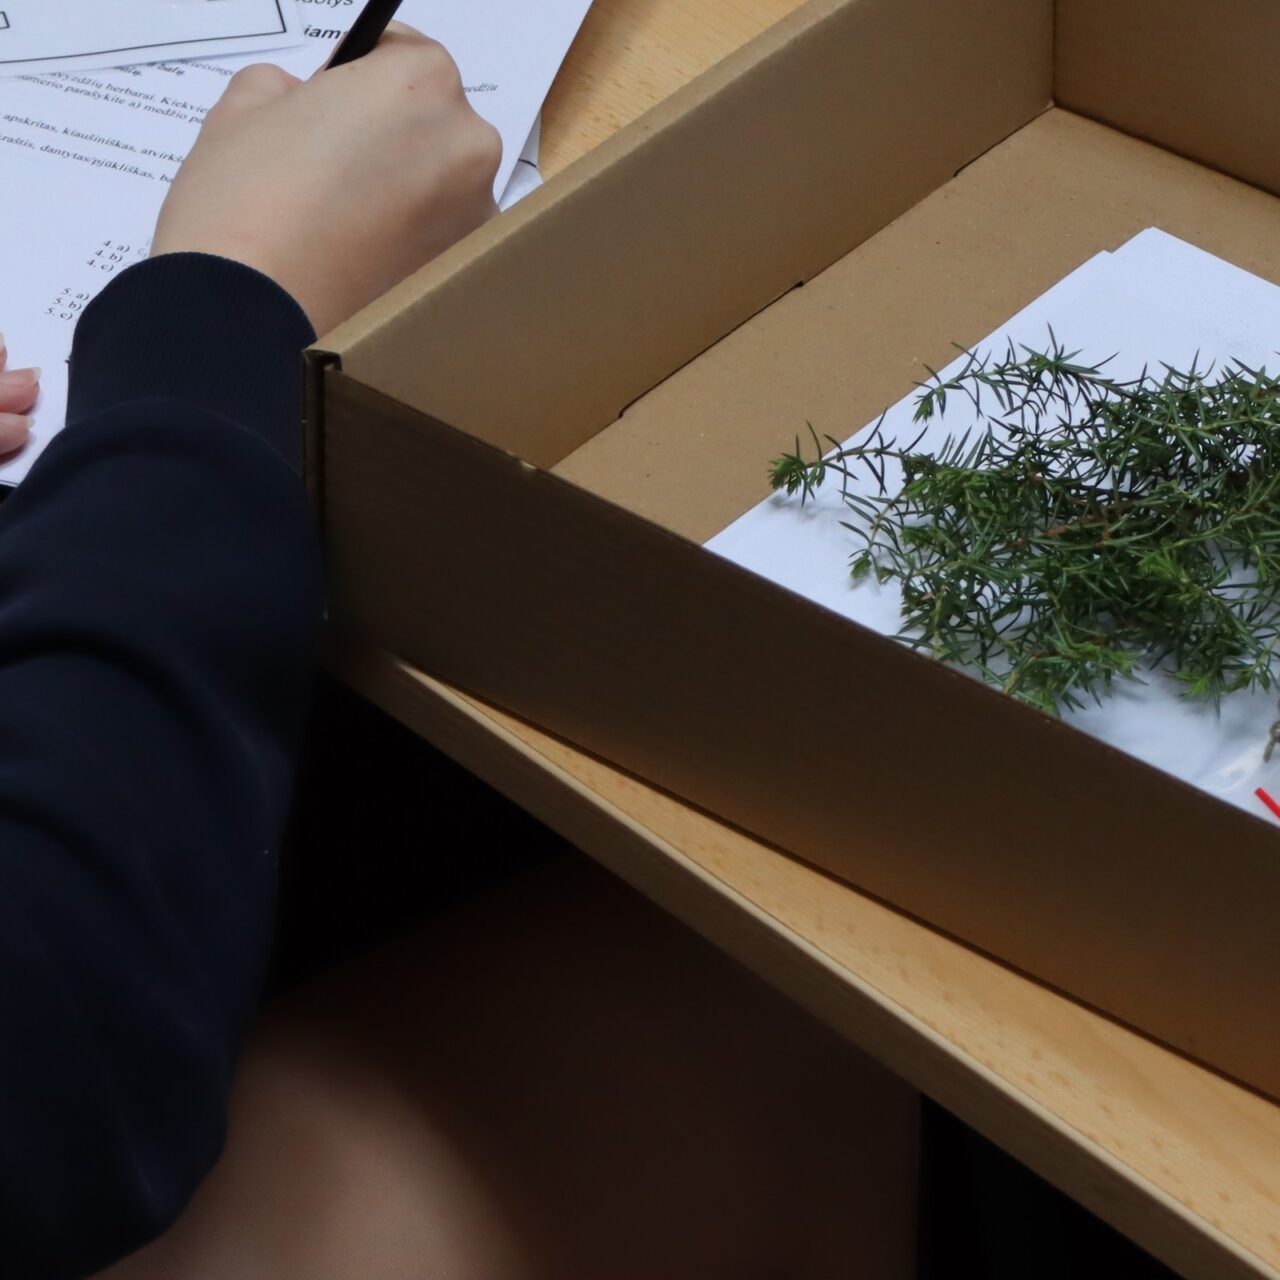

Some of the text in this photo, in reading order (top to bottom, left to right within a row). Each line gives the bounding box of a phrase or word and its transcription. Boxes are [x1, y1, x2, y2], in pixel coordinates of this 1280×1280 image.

[20, 74, 63, 90] umerio
[47, 71, 104, 90] avyzdžių
[160, 96, 210, 114] Kiekvie
